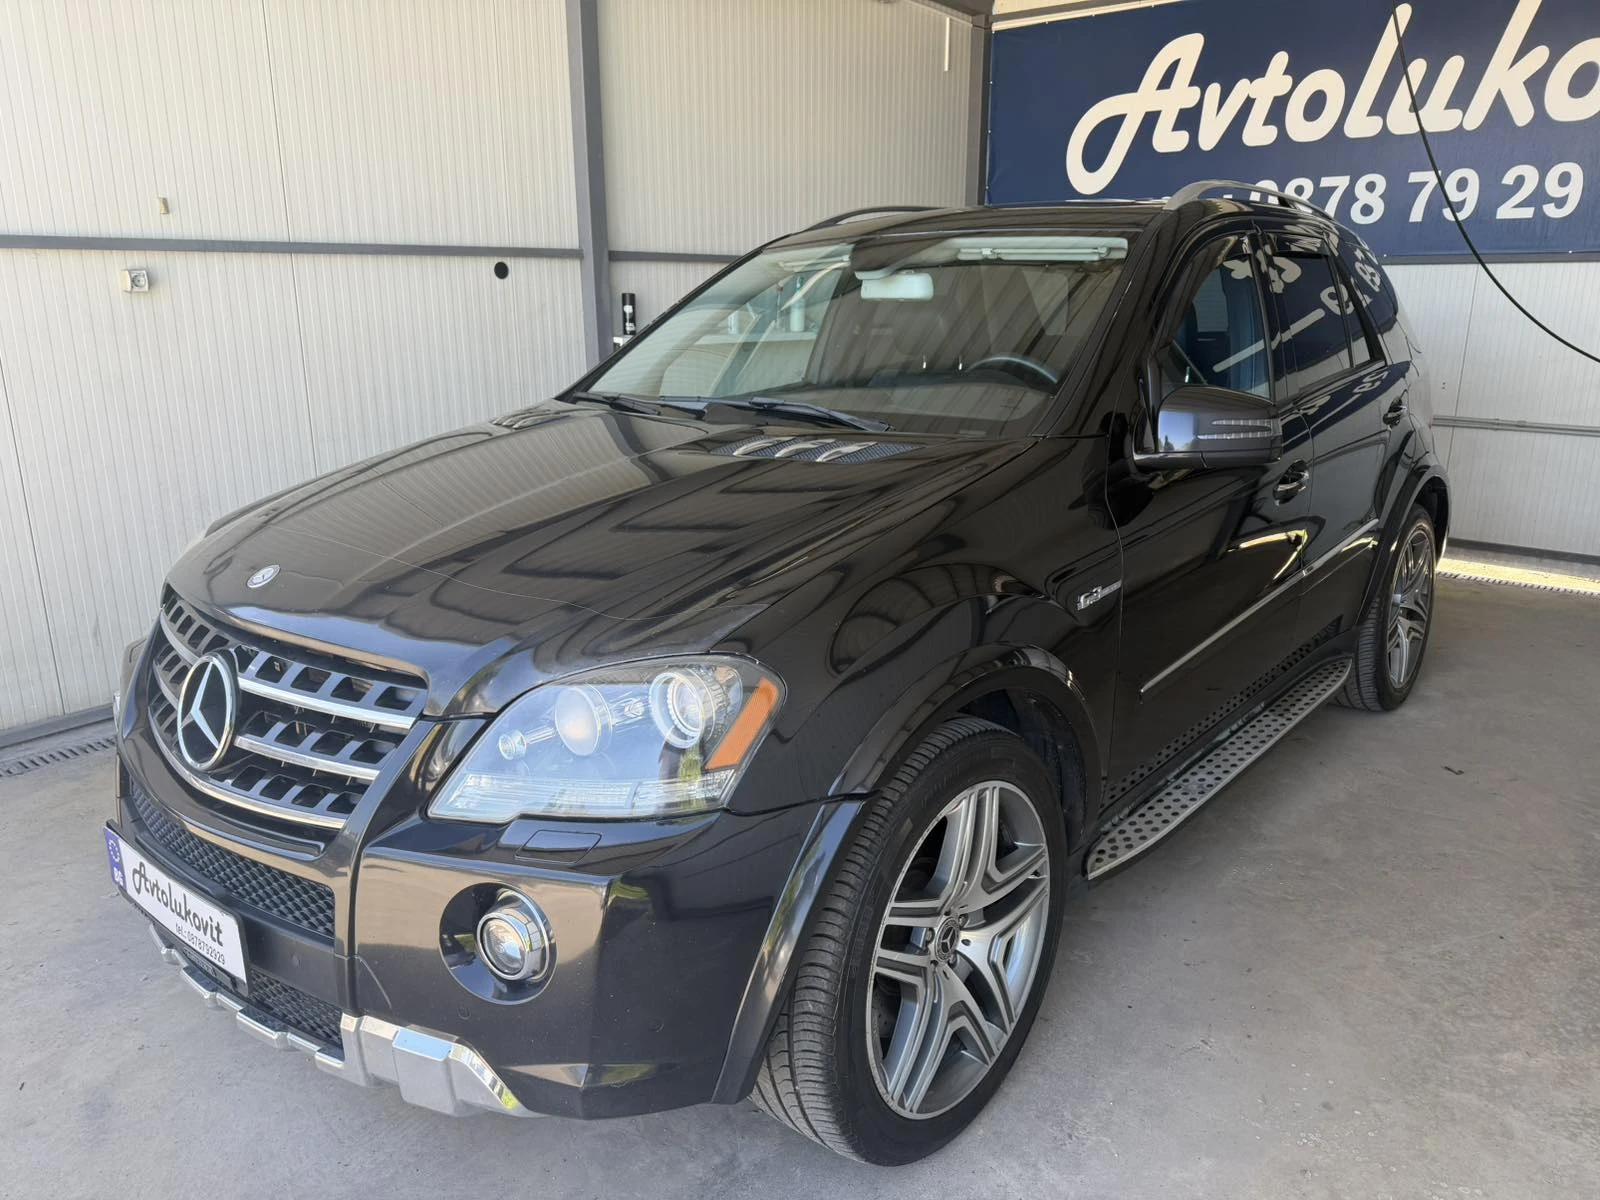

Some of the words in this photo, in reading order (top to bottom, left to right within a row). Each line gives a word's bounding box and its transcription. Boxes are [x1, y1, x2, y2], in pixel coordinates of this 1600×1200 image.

[1408, 168, 1480, 222] 79
[1496, 162, 1583, 219] 29
[132, 861, 223, 946] Avtolukovit
